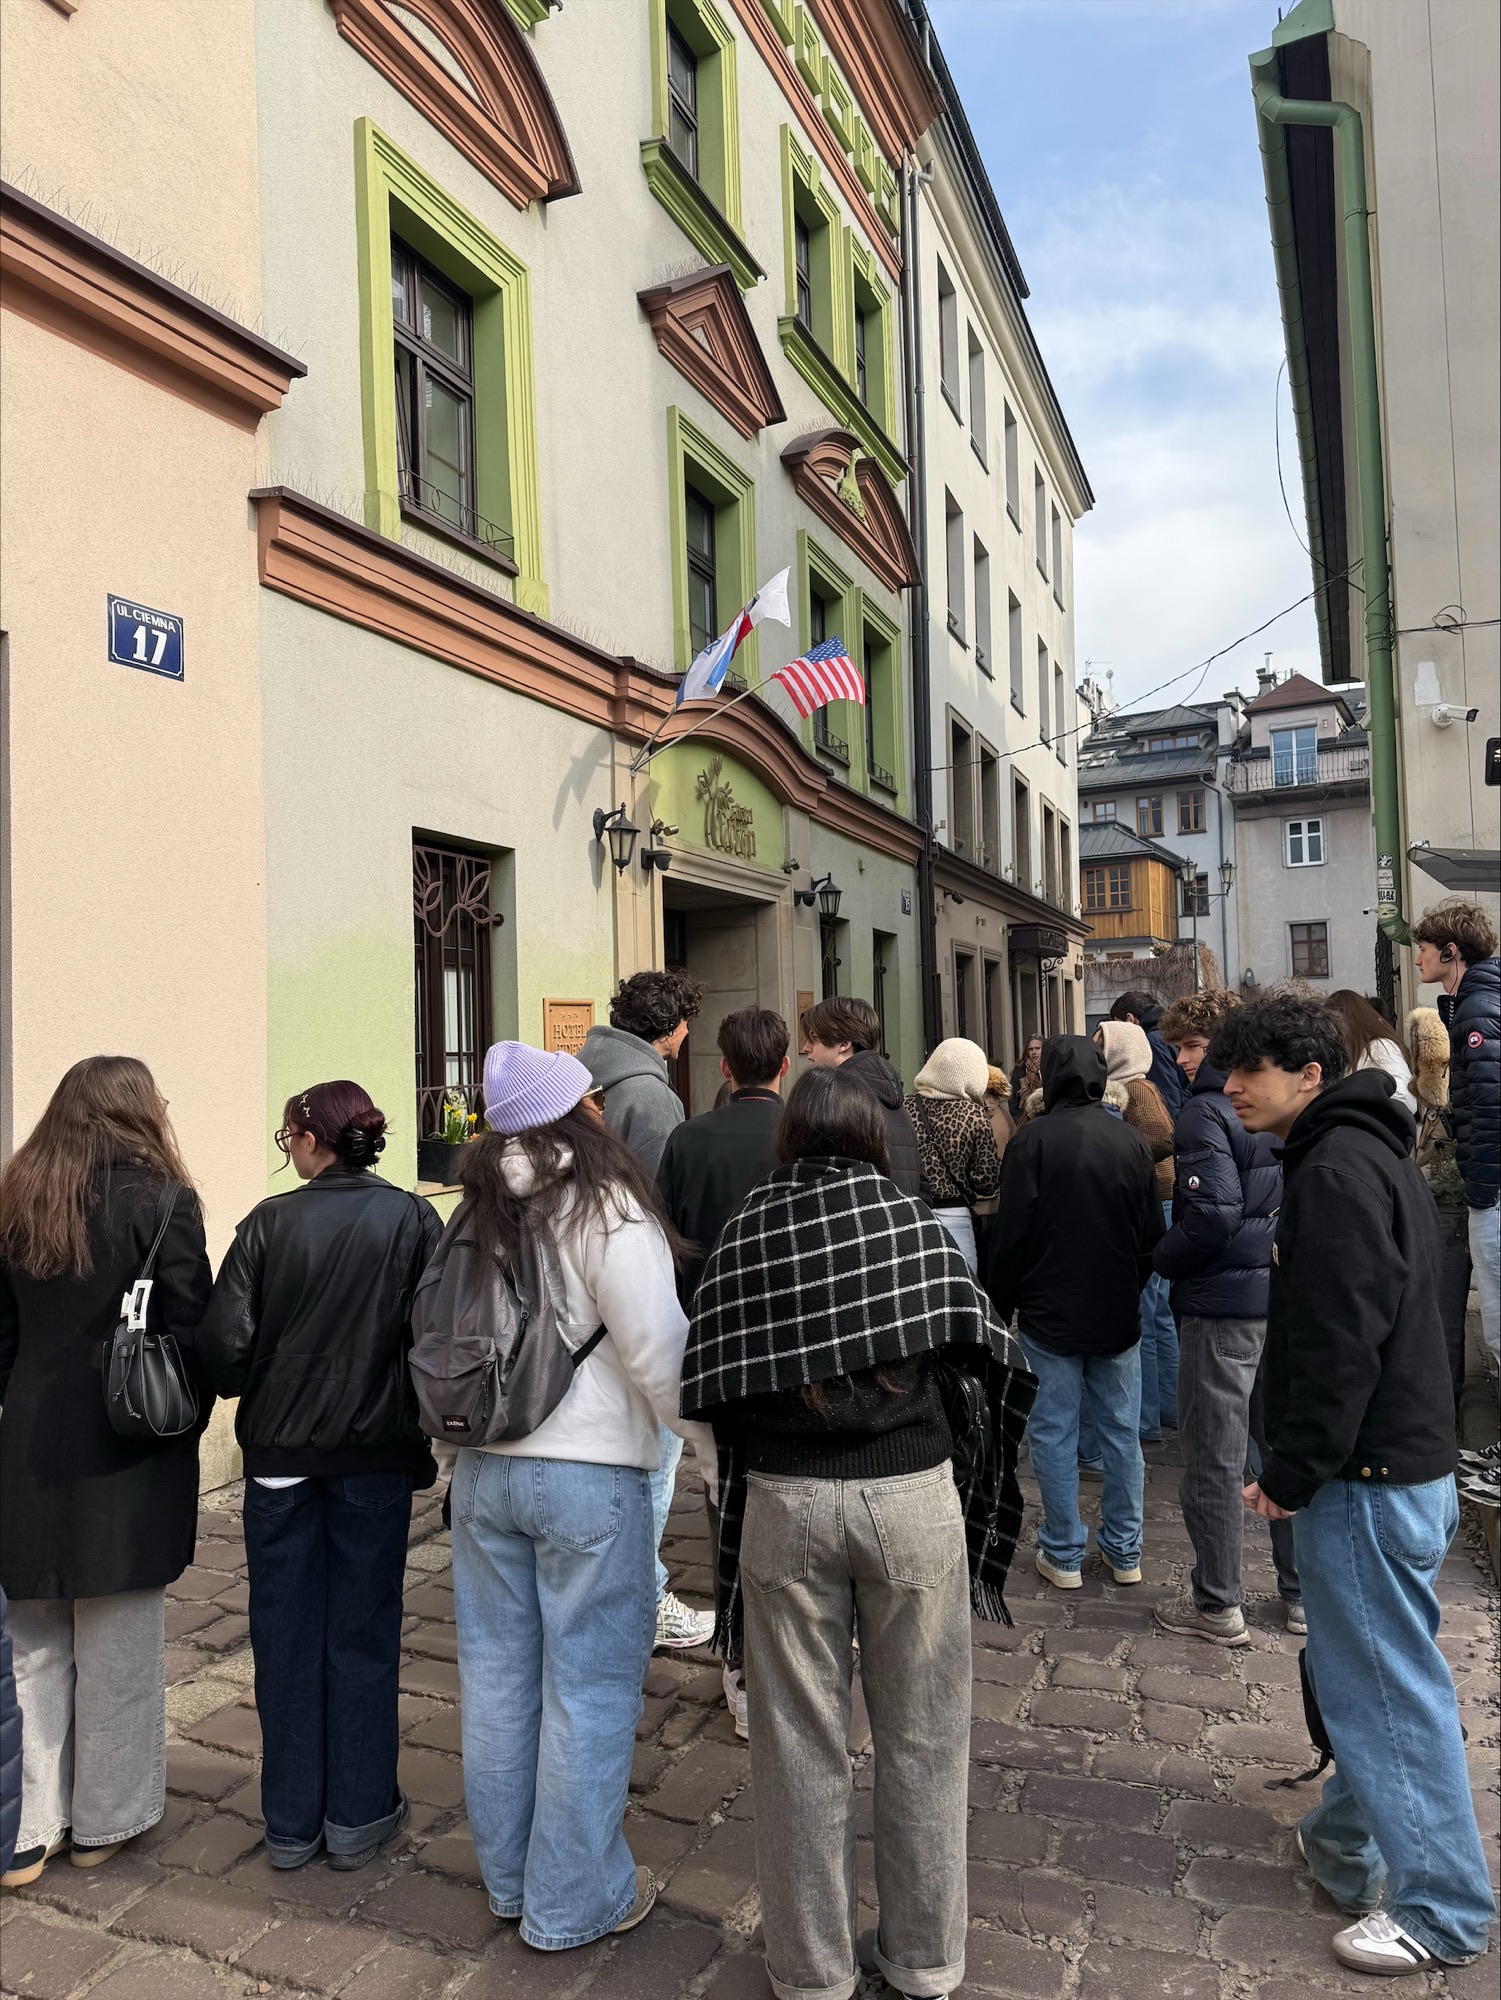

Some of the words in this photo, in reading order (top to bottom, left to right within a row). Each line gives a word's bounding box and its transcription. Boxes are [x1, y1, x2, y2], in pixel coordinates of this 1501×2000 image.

[116, 603, 132, 618] UL.
[132, 608, 177, 633] CIEMNA
[132, 624, 168, 665] 17
[553, 1024, 586, 1039] HOTEL
